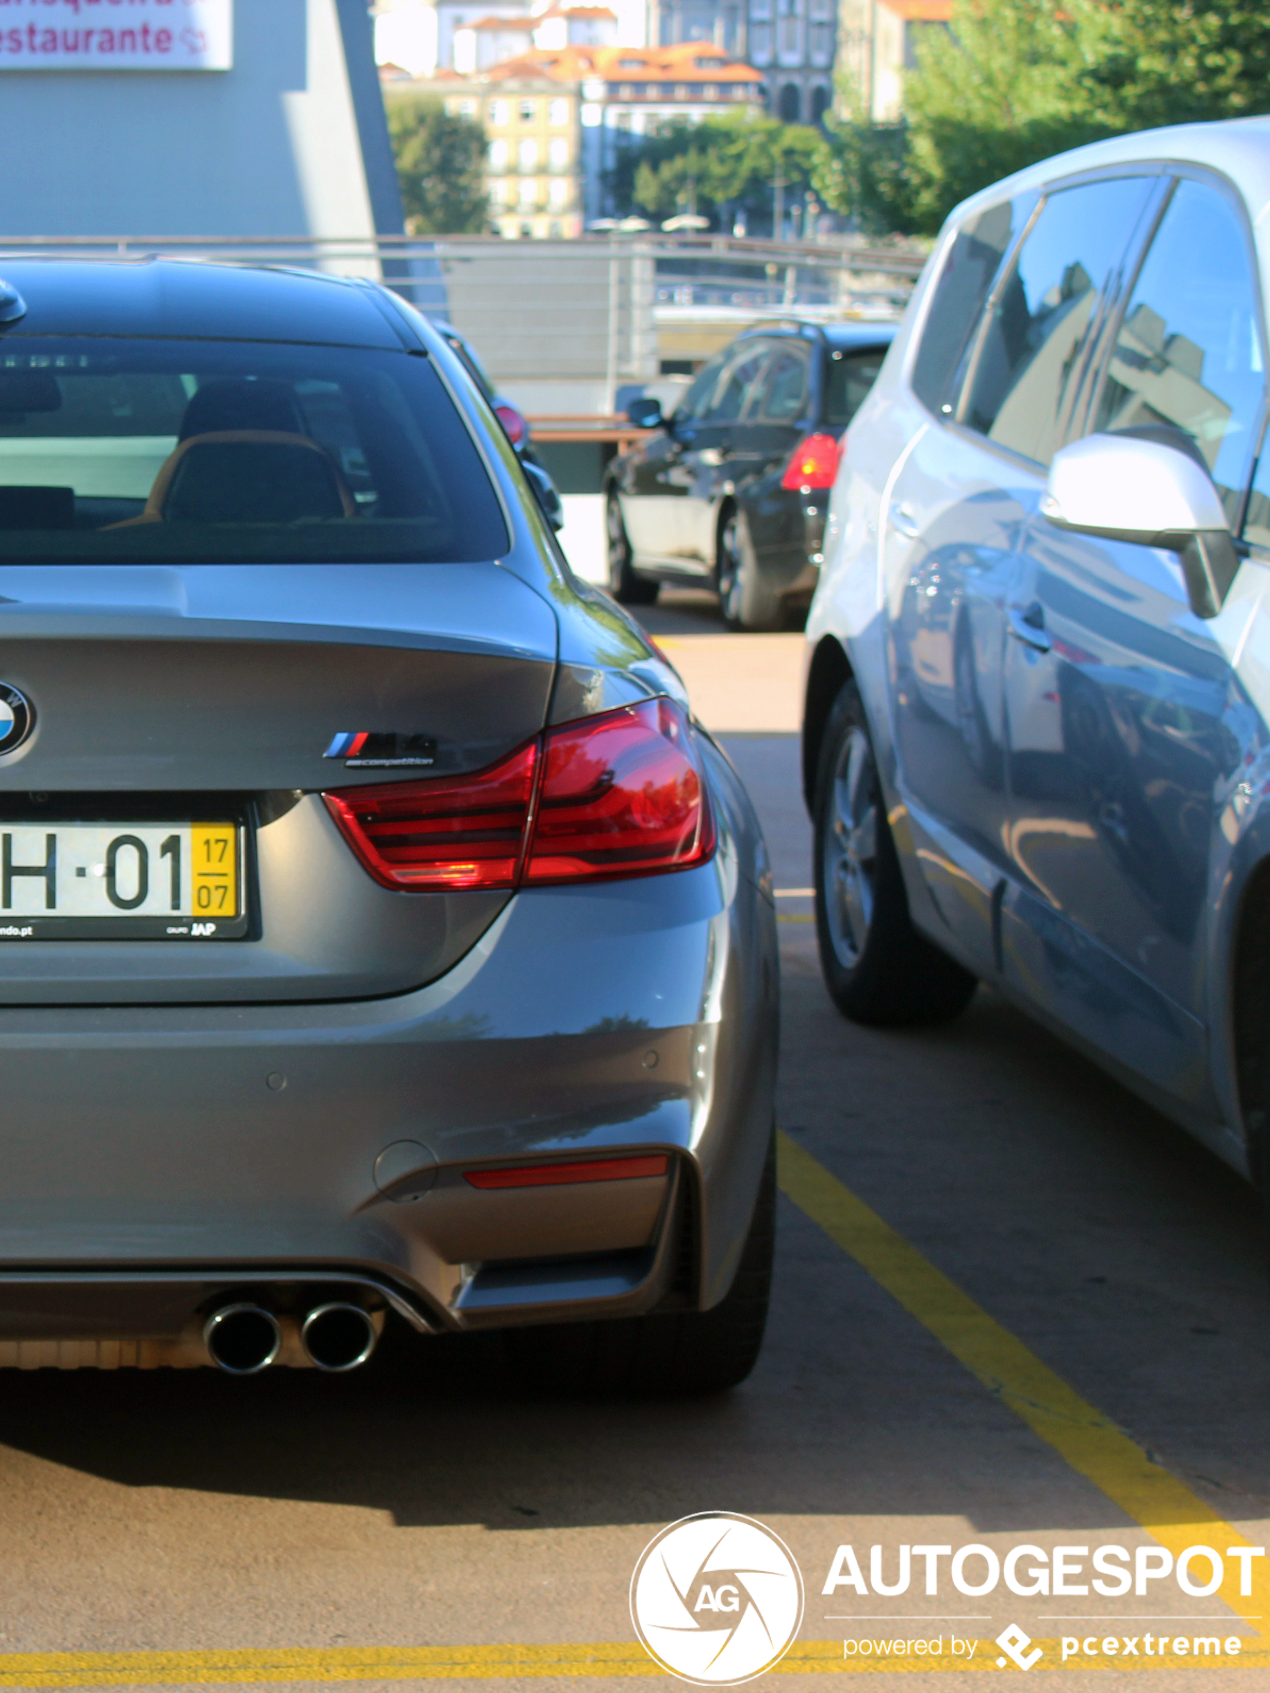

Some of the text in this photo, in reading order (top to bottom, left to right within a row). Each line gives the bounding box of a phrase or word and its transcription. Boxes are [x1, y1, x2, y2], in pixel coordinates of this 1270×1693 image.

[203, 838, 229, 863] 17
[197, 884, 230, 910] 07
[190, 922, 217, 936] JAP
